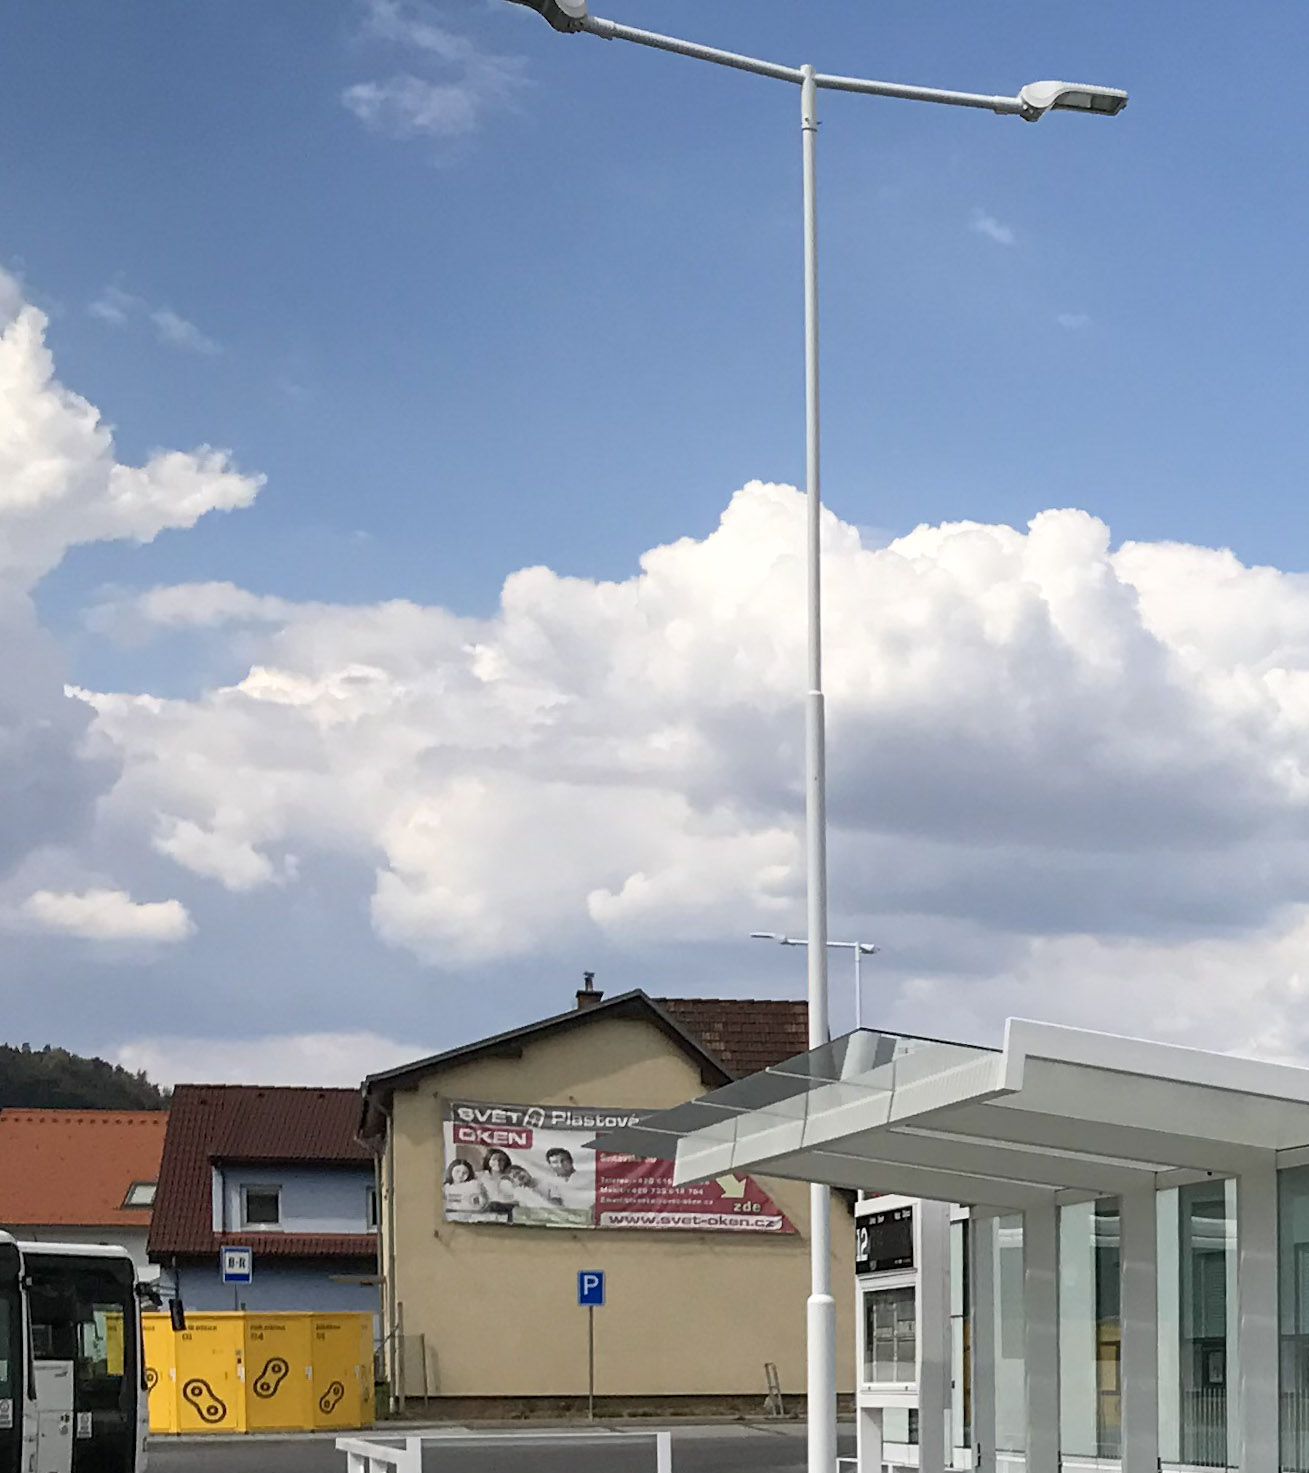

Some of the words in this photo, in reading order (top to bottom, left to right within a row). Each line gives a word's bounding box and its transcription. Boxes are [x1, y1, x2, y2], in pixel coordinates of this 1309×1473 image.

[458, 1127, 527, 1146] OKEN
[733, 1200, 762, 1213] zde
[608, 1214, 777, 1228] www.svet-oken.cz
[856, 1227, 868, 1262] 12
[583, 1274, 599, 1296] P
